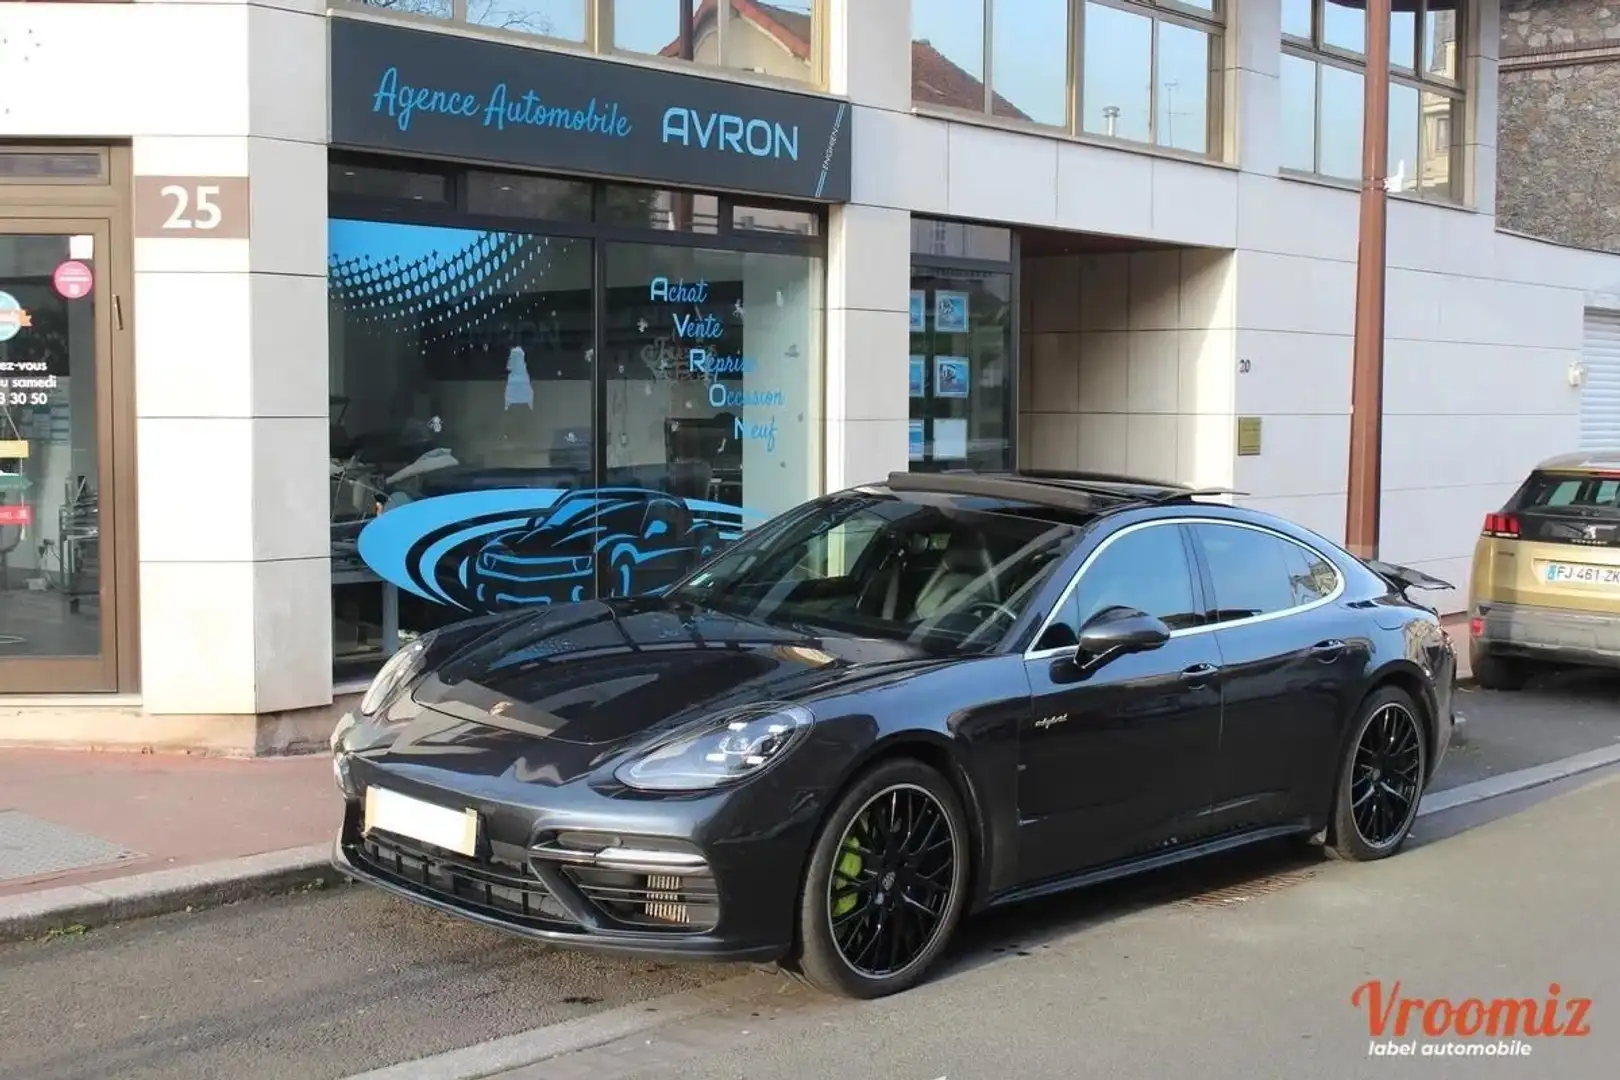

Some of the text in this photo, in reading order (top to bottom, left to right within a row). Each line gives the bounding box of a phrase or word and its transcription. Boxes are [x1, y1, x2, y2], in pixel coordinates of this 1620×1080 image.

[372, 67, 632, 137] Agence Automobile
[662, 107, 799, 161] AVRON
[161, 185, 222, 229] 25
[651, 277, 708, 303] Achat
[673, 313, 723, 338] Vente
[689, 348, 756, 382] Repri
[1240, 359, 1251, 374] 20
[12, 374, 57, 388] samedi
[10, 392, 26, 405] 30
[30, 392, 47, 405] 50
[709, 383, 784, 408] Occsion
[734, 415, 778, 452] Neuf
